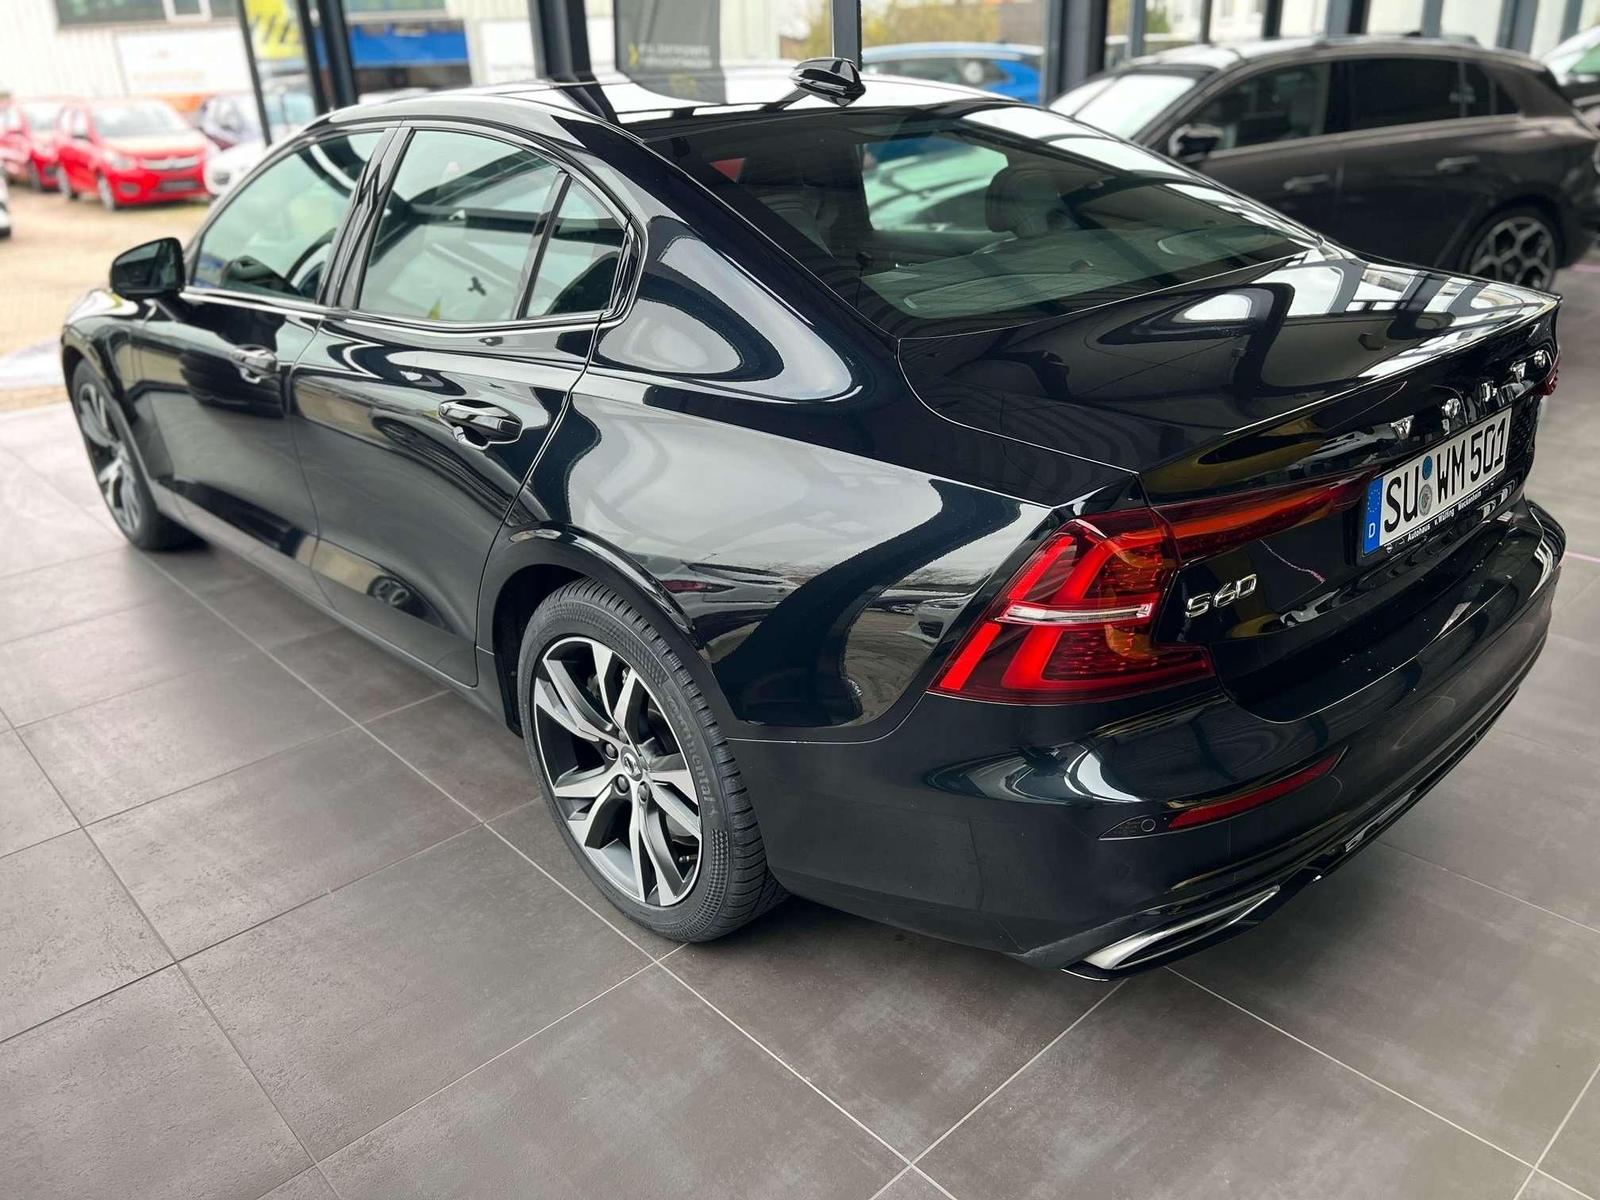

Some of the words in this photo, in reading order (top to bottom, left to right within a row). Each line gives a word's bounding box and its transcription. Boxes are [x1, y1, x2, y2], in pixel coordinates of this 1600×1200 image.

[1384, 465, 1419, 533] SU
[1436, 439, 1466, 504] WM
[1470, 417, 1506, 482] 501
[1368, 522, 1376, 538] D
[1407, 523, 1431, 541] Autohaus
[1185, 573, 1257, 618] S60
[666, 694, 717, 803] Continental
